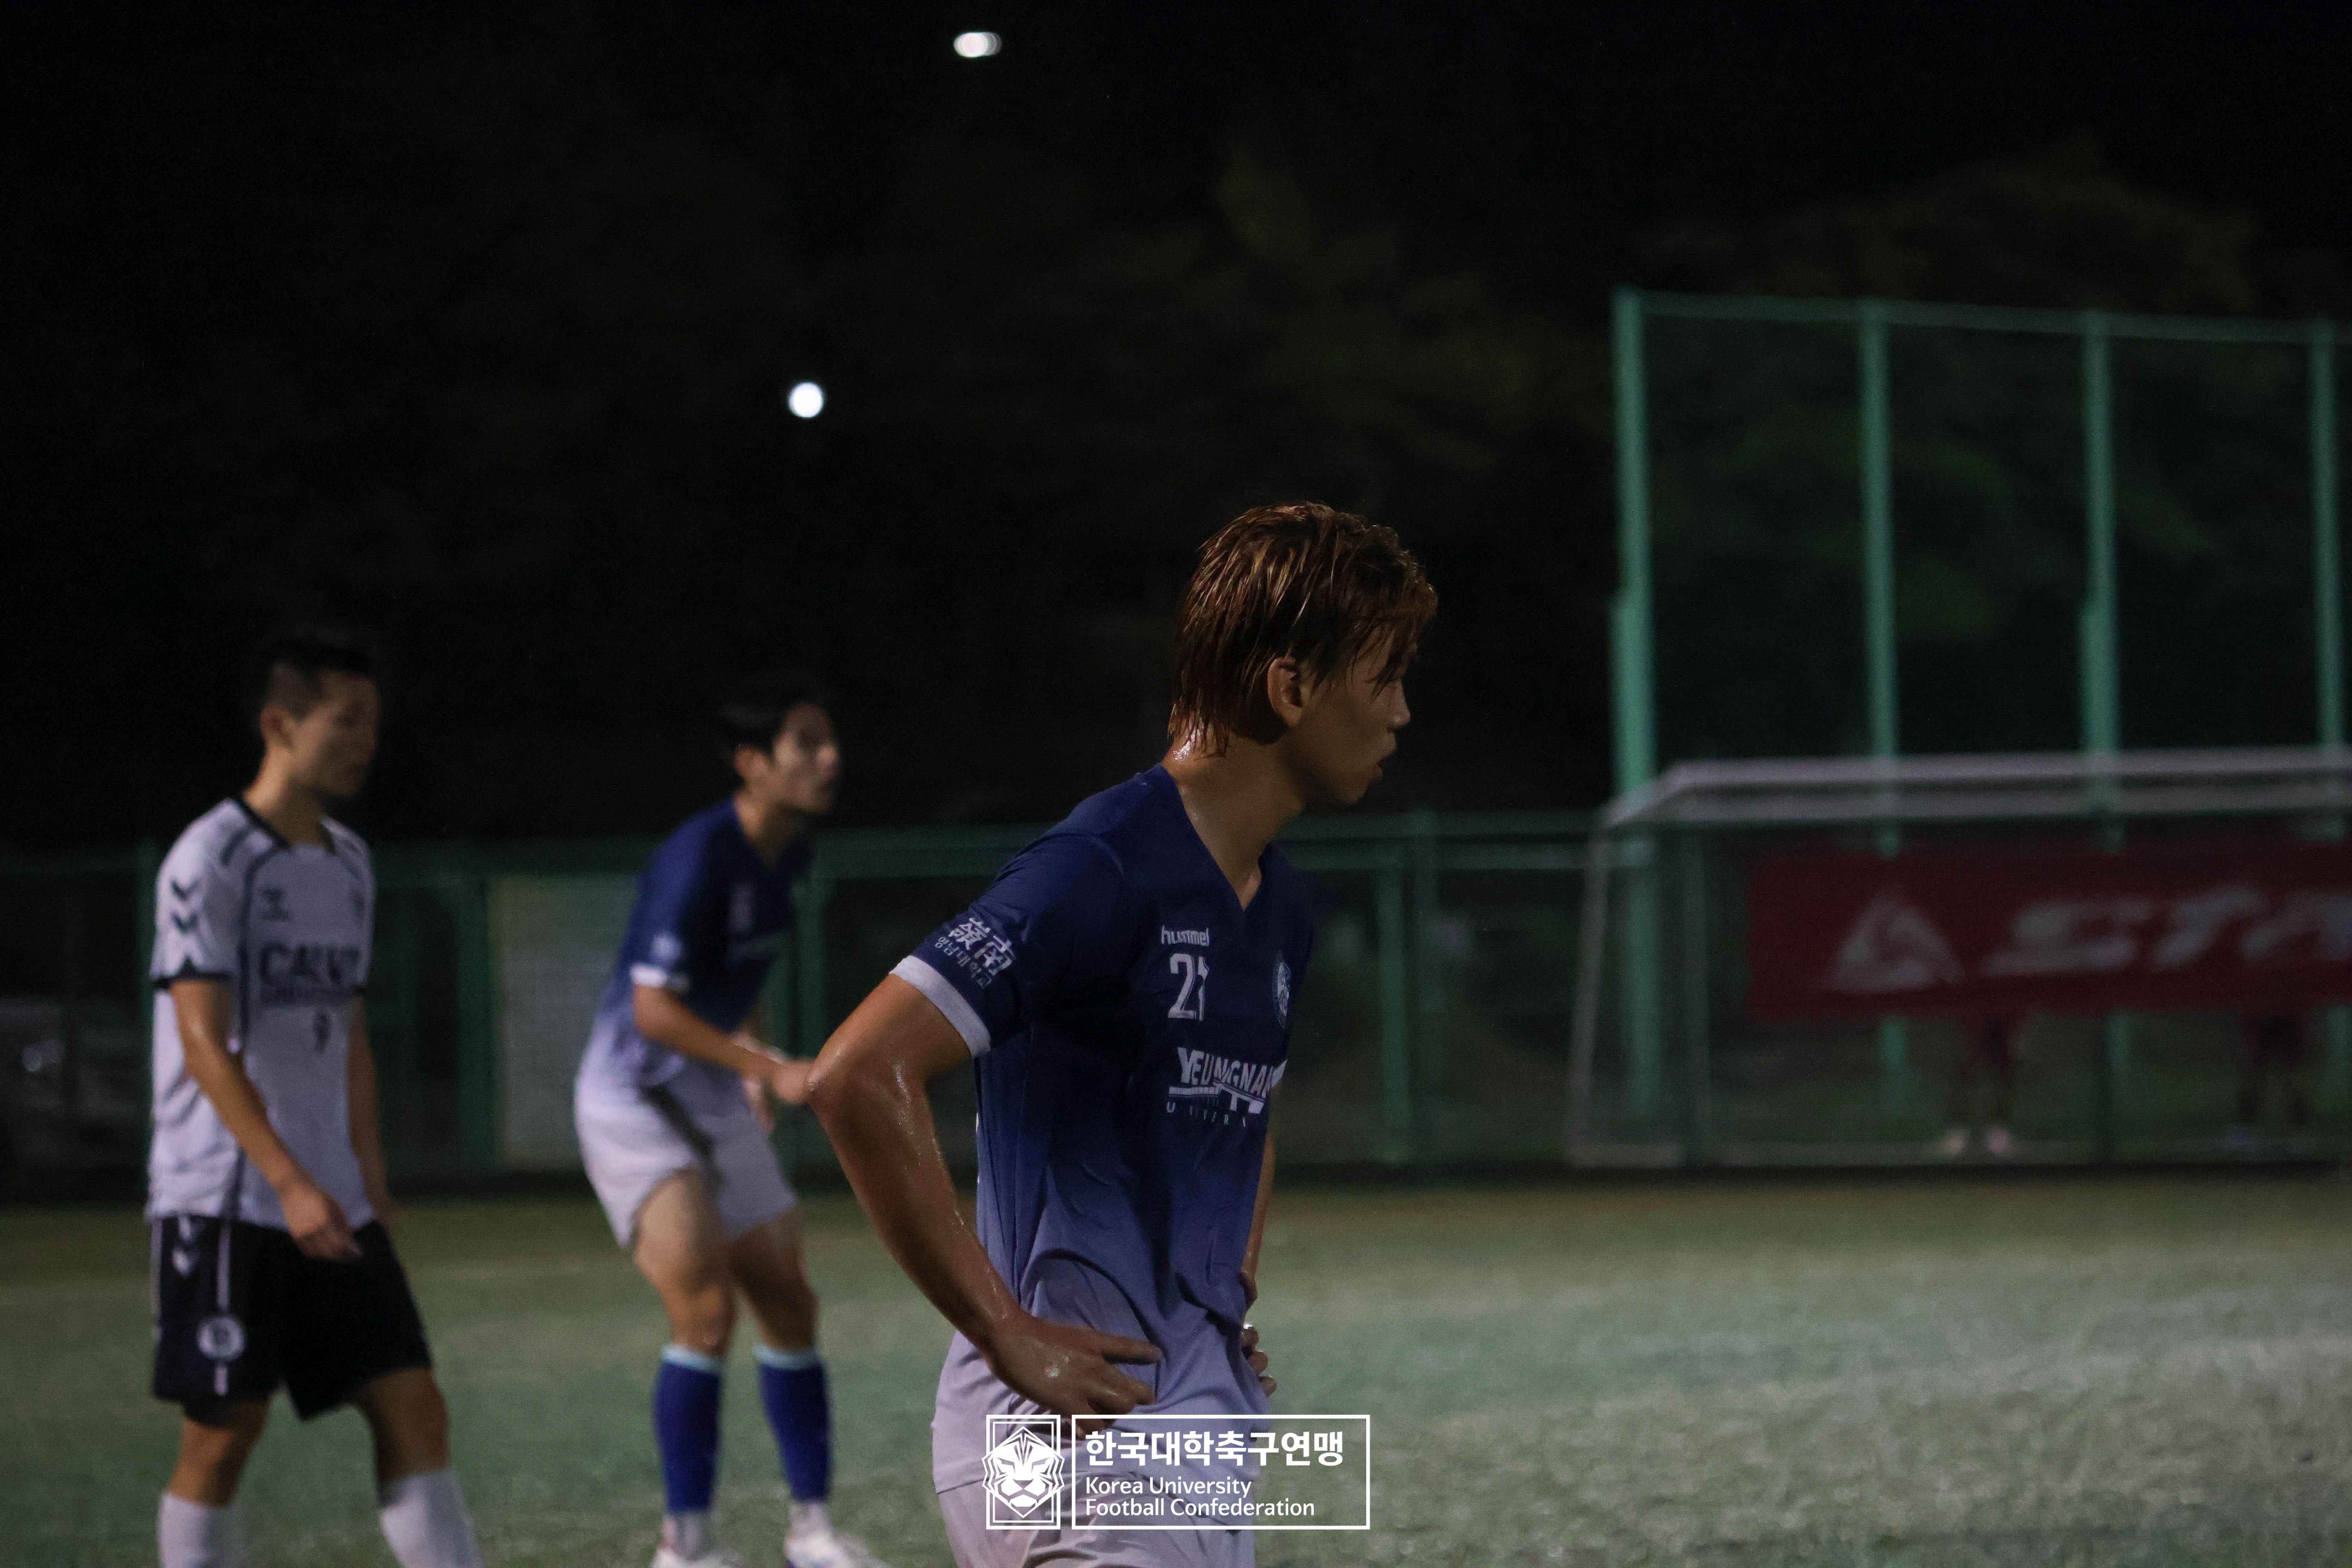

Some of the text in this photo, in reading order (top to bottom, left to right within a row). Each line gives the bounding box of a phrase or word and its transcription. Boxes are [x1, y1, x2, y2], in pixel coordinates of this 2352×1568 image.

[935, 936, 993, 990] 영남대학교
[949, 917, 1017, 976] 嶺南
[1161, 925, 1210, 947] hummel
